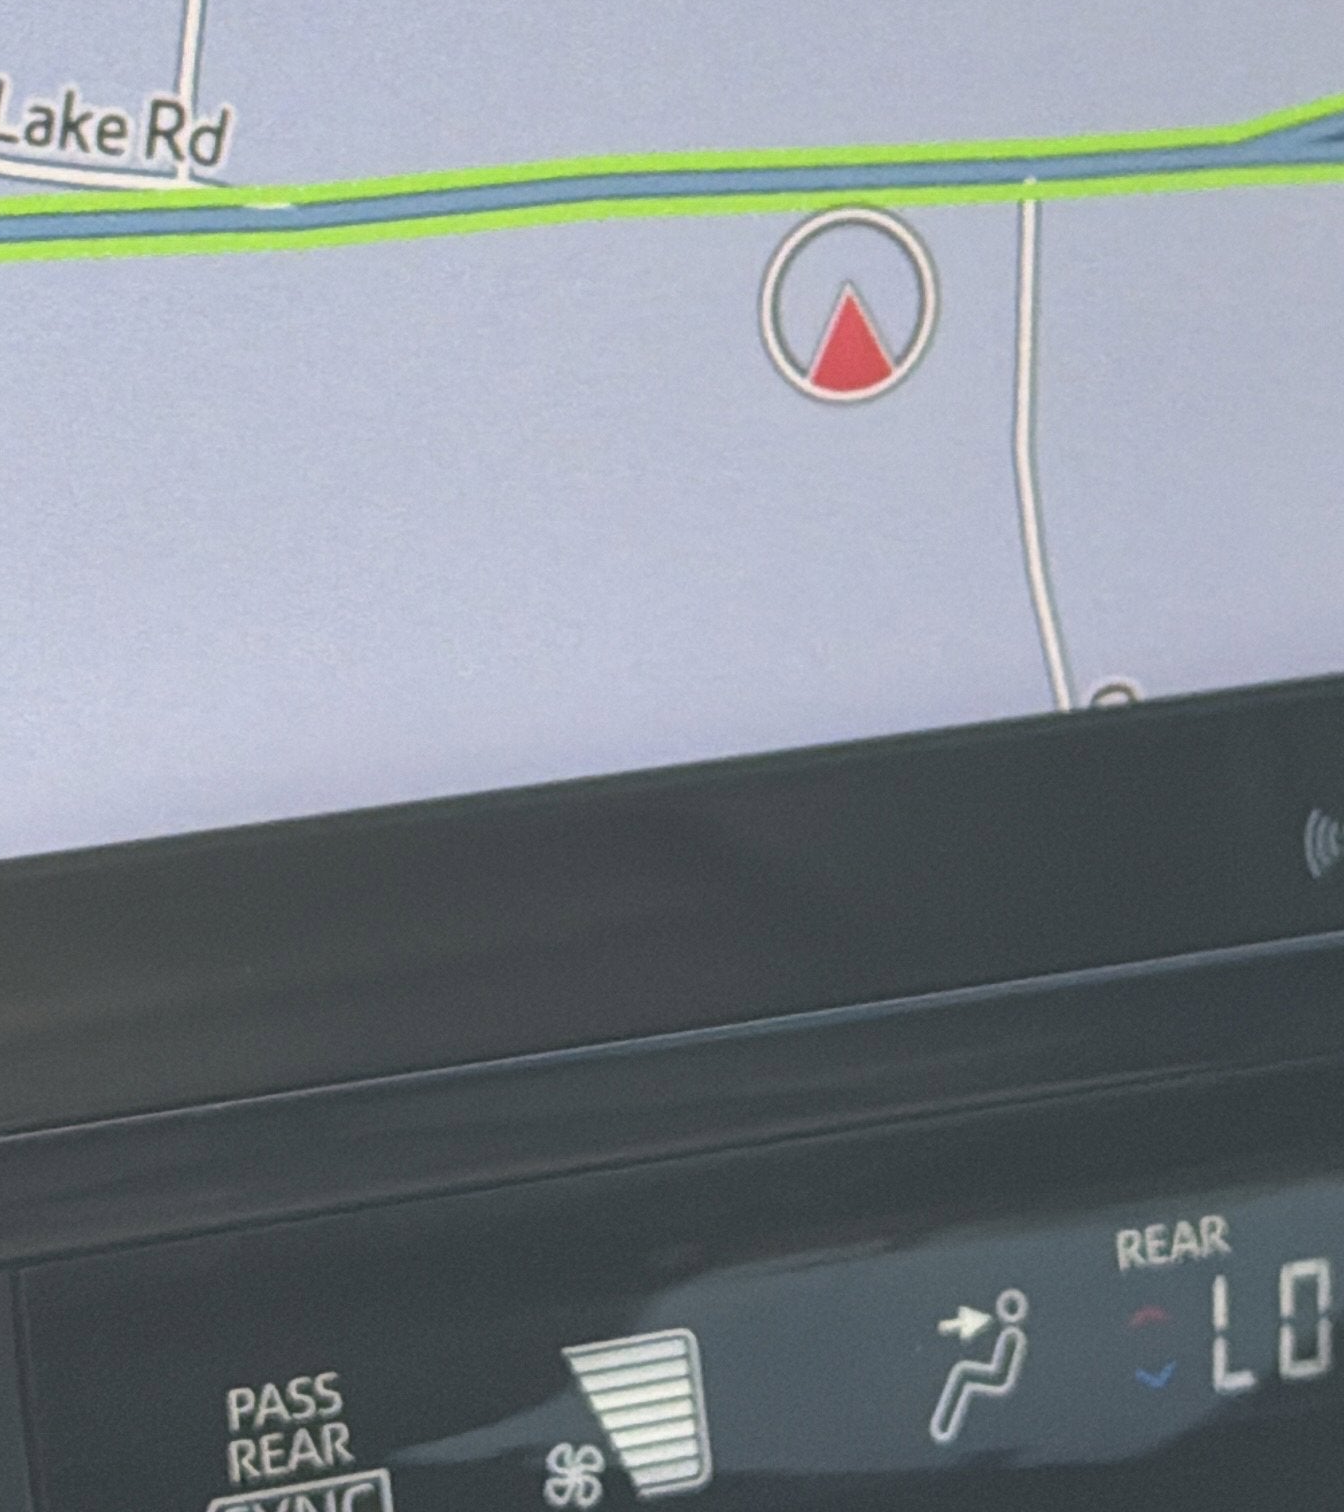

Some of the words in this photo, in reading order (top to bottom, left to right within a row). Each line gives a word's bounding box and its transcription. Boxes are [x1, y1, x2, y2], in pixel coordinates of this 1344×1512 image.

[146, 98, 231, 168] Rd
[1117, 1214, 1231, 1271] REAR
[228, 1371, 343, 1432] PASS
[228, 1421, 355, 1484] REAR
